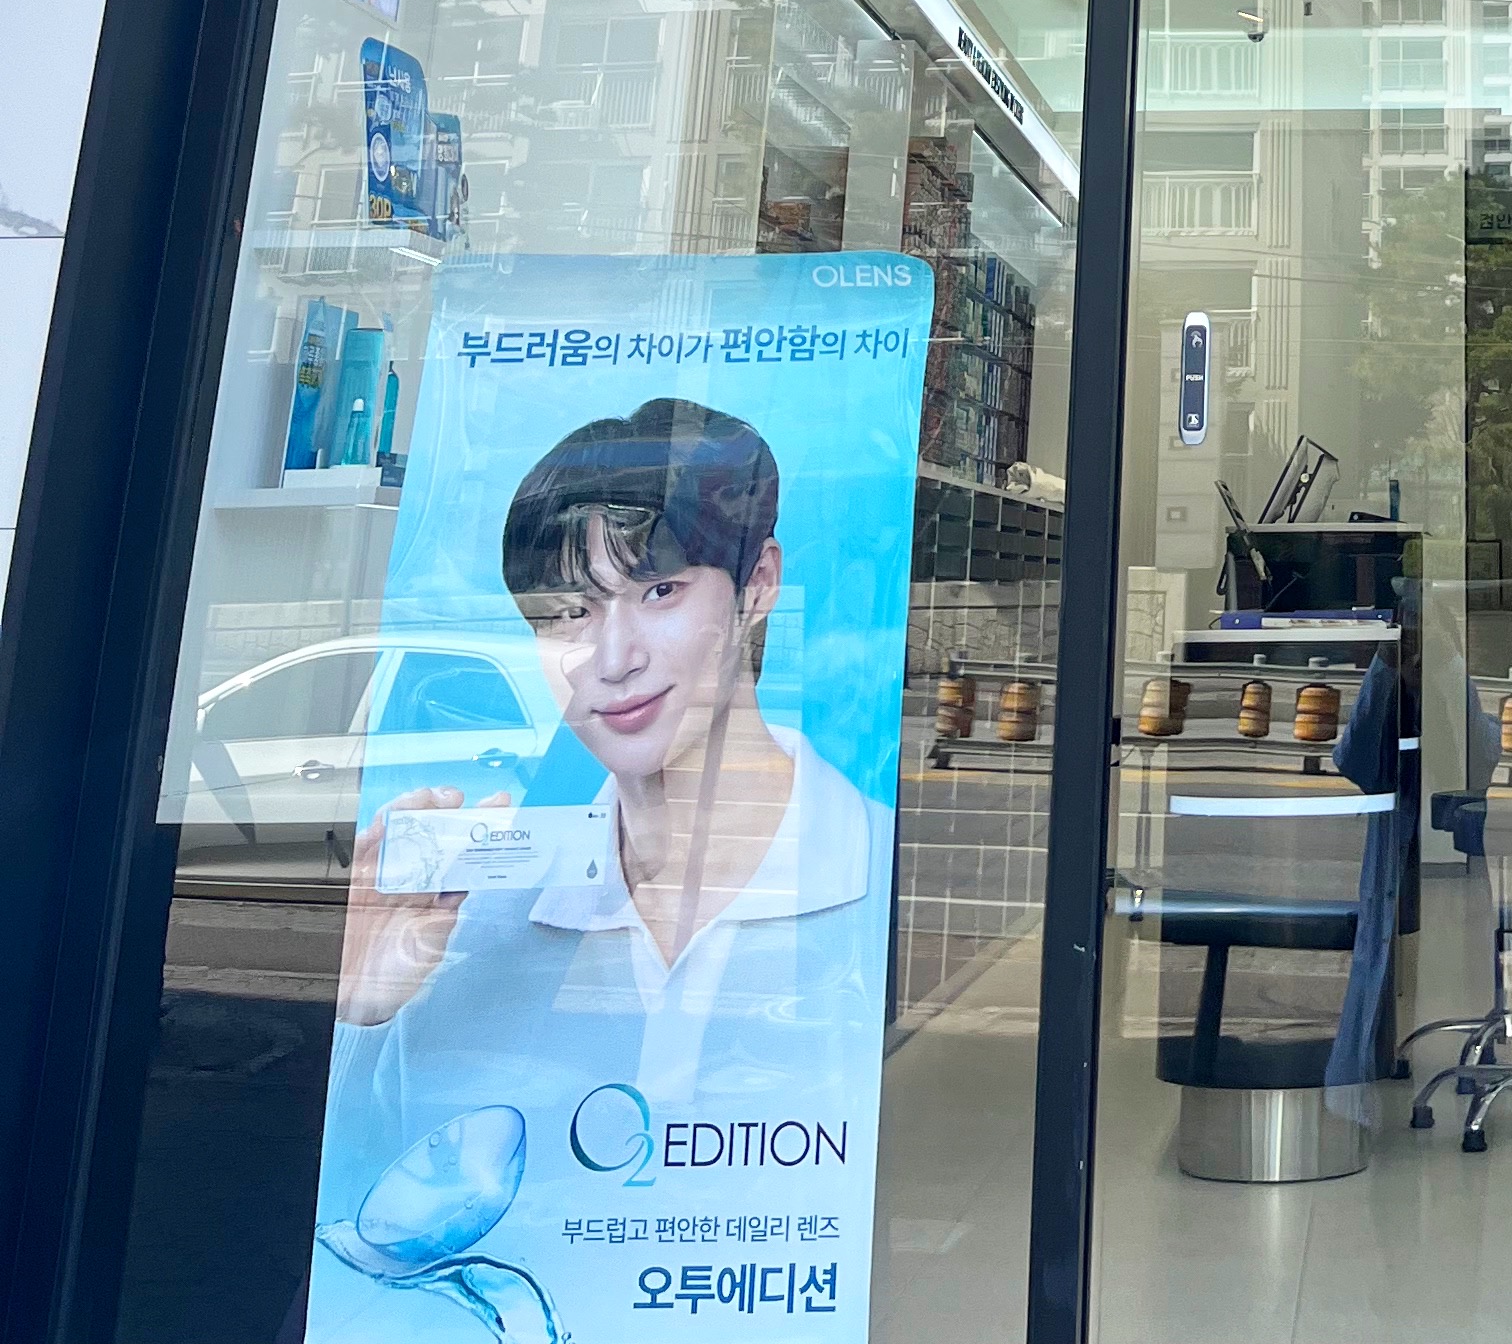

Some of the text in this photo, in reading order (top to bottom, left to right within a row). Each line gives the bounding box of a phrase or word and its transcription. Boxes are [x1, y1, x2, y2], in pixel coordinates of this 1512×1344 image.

[811, 264, 913, 289] OLENS
[456, 325, 911, 369] 부드러움의 차이가 편안함의 차이
[1185, 374, 1205, 382] PUSH
[663, 1120, 848, 1167] EDITION
[561, 1214, 841, 1245] 부드럽고 편안한 데일리 렌즈
[633, 1262, 838, 1315] 오투에디션
